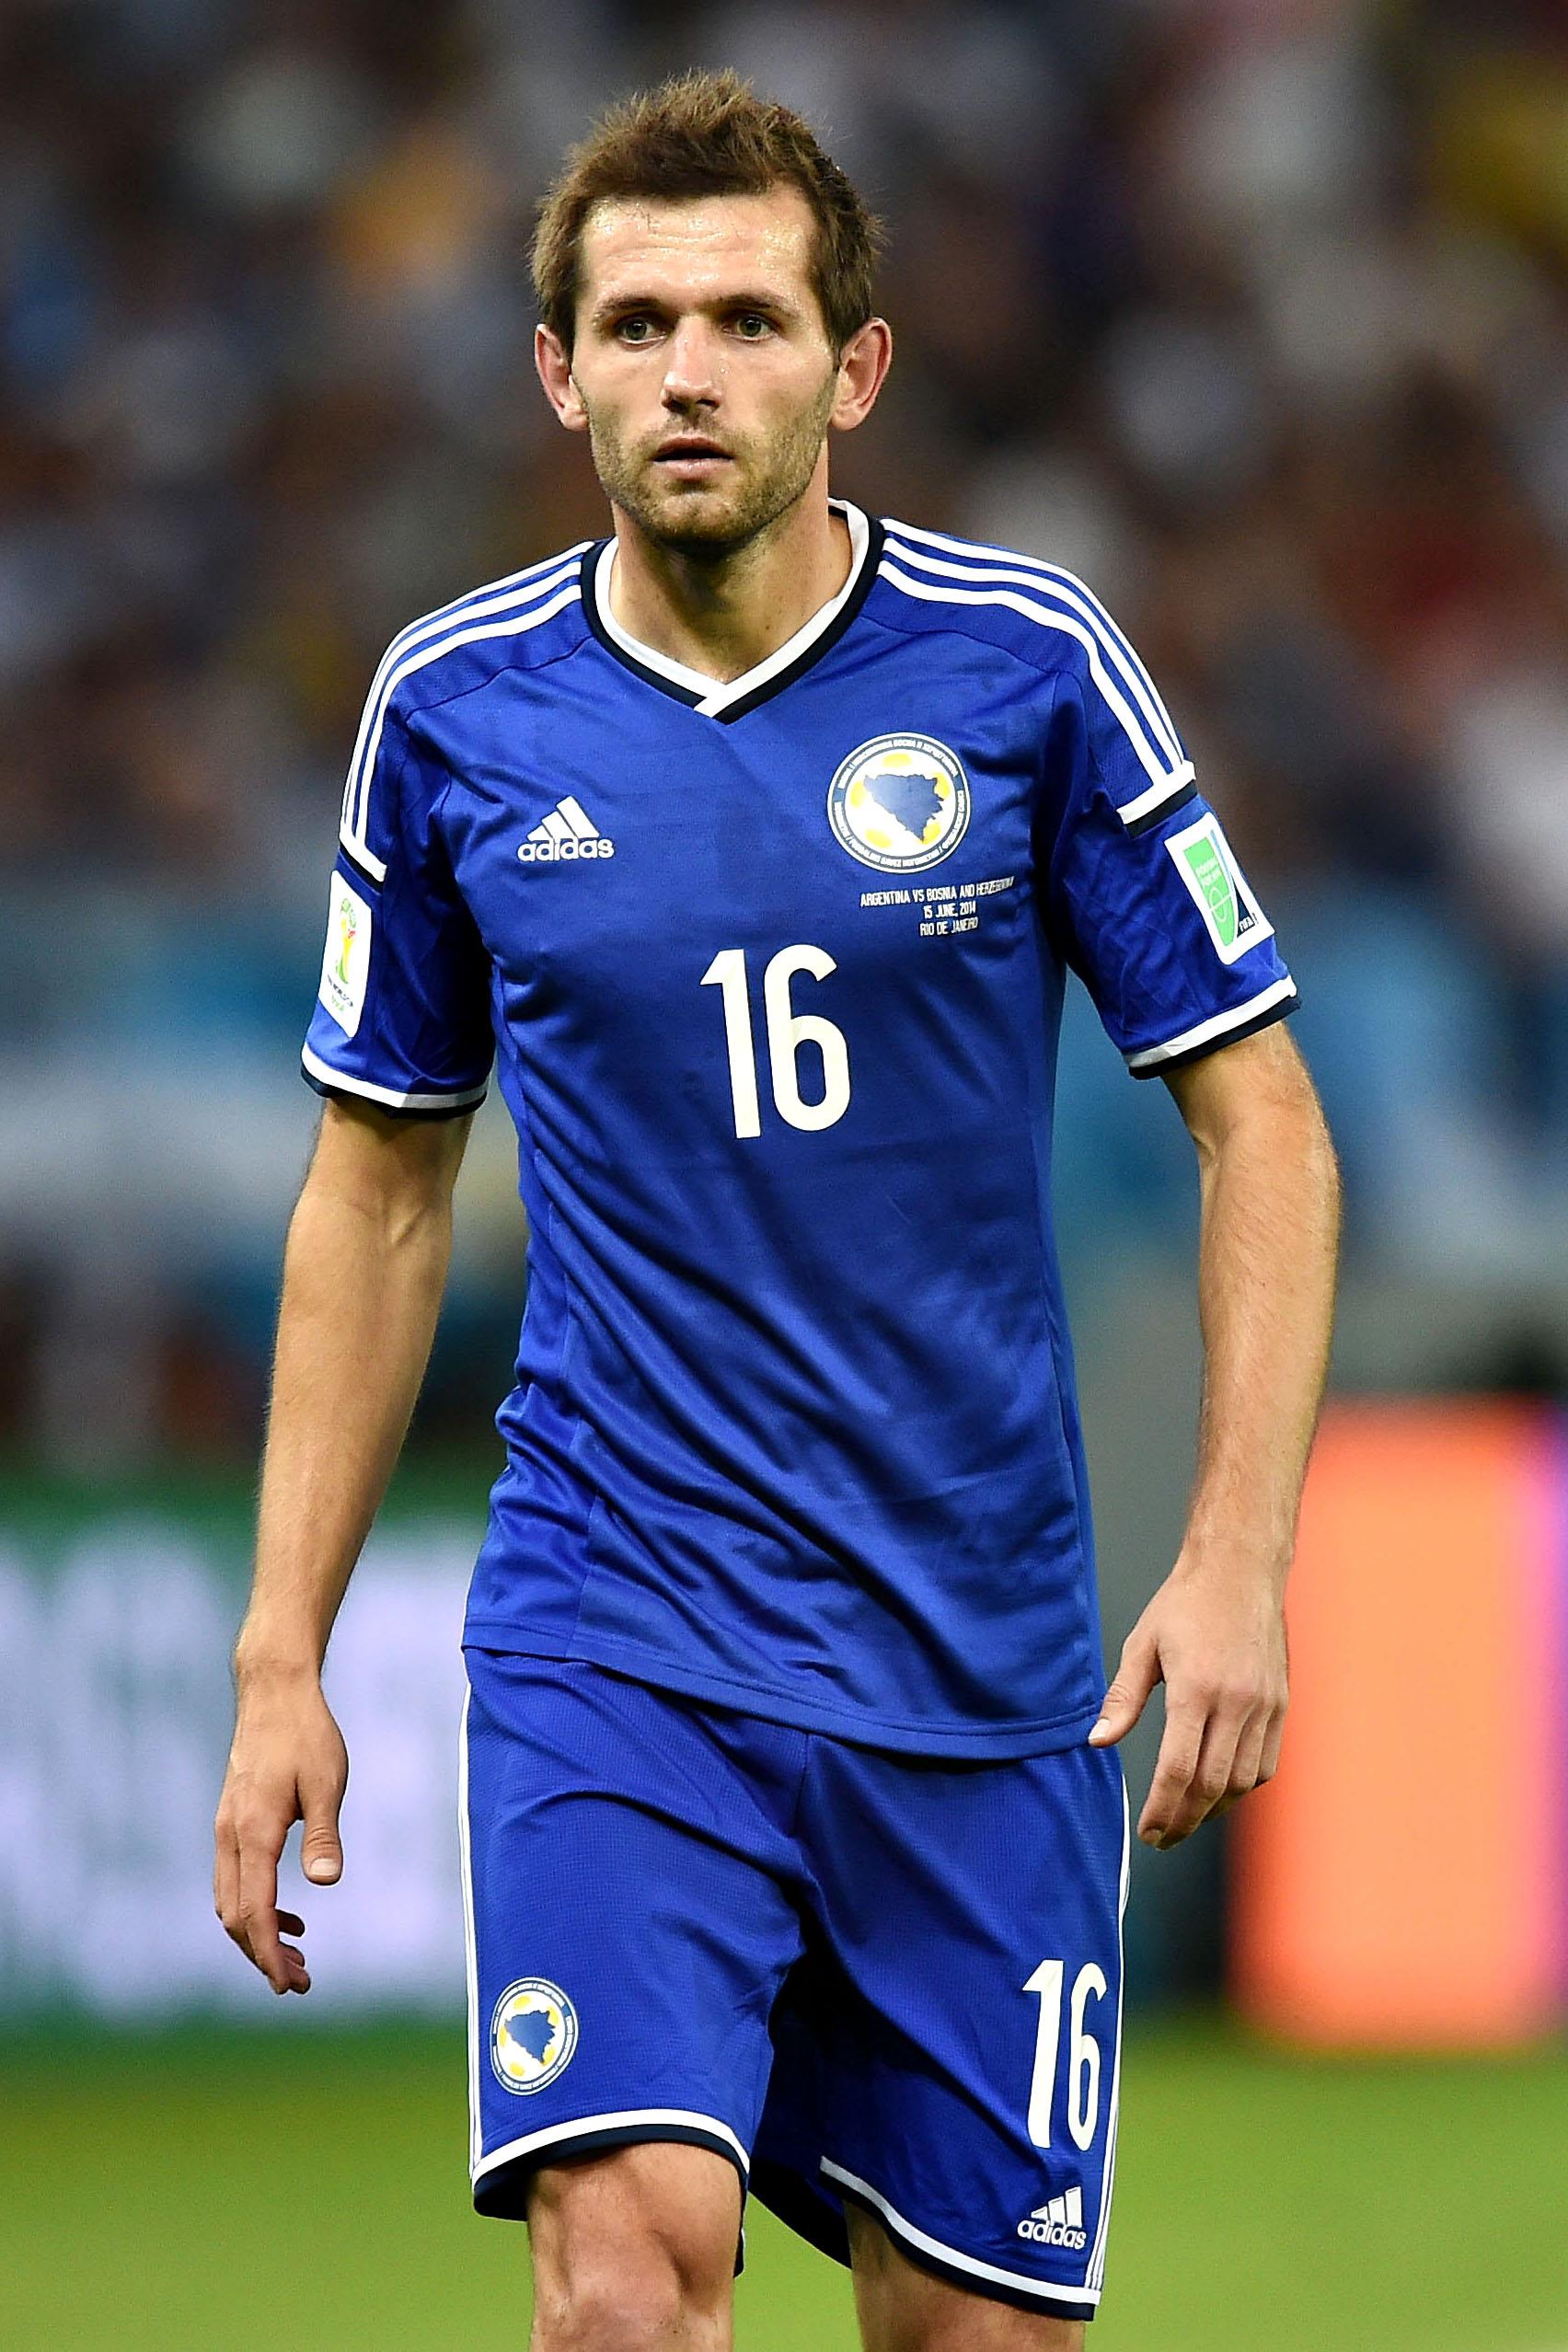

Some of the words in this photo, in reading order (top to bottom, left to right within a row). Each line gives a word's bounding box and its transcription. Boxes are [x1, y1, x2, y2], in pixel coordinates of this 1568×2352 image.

[517, 837, 615, 862] adidas
[860, 889, 910, 907] ARGENTINA
[912, 889, 925, 903] VS
[927, 886, 957, 902] BOSNIA
[960, 883, 975, 898] AND
[923, 905, 933, 919] 15
[959, 900, 977, 915] 2014
[920, 921, 935, 937] RIO
[937, 921, 949, 935] DE
[700, 944, 851, 1139] 16
[1021, 1959, 1108, 2151] 16
[1017, 2219, 1087, 2250] adidas
